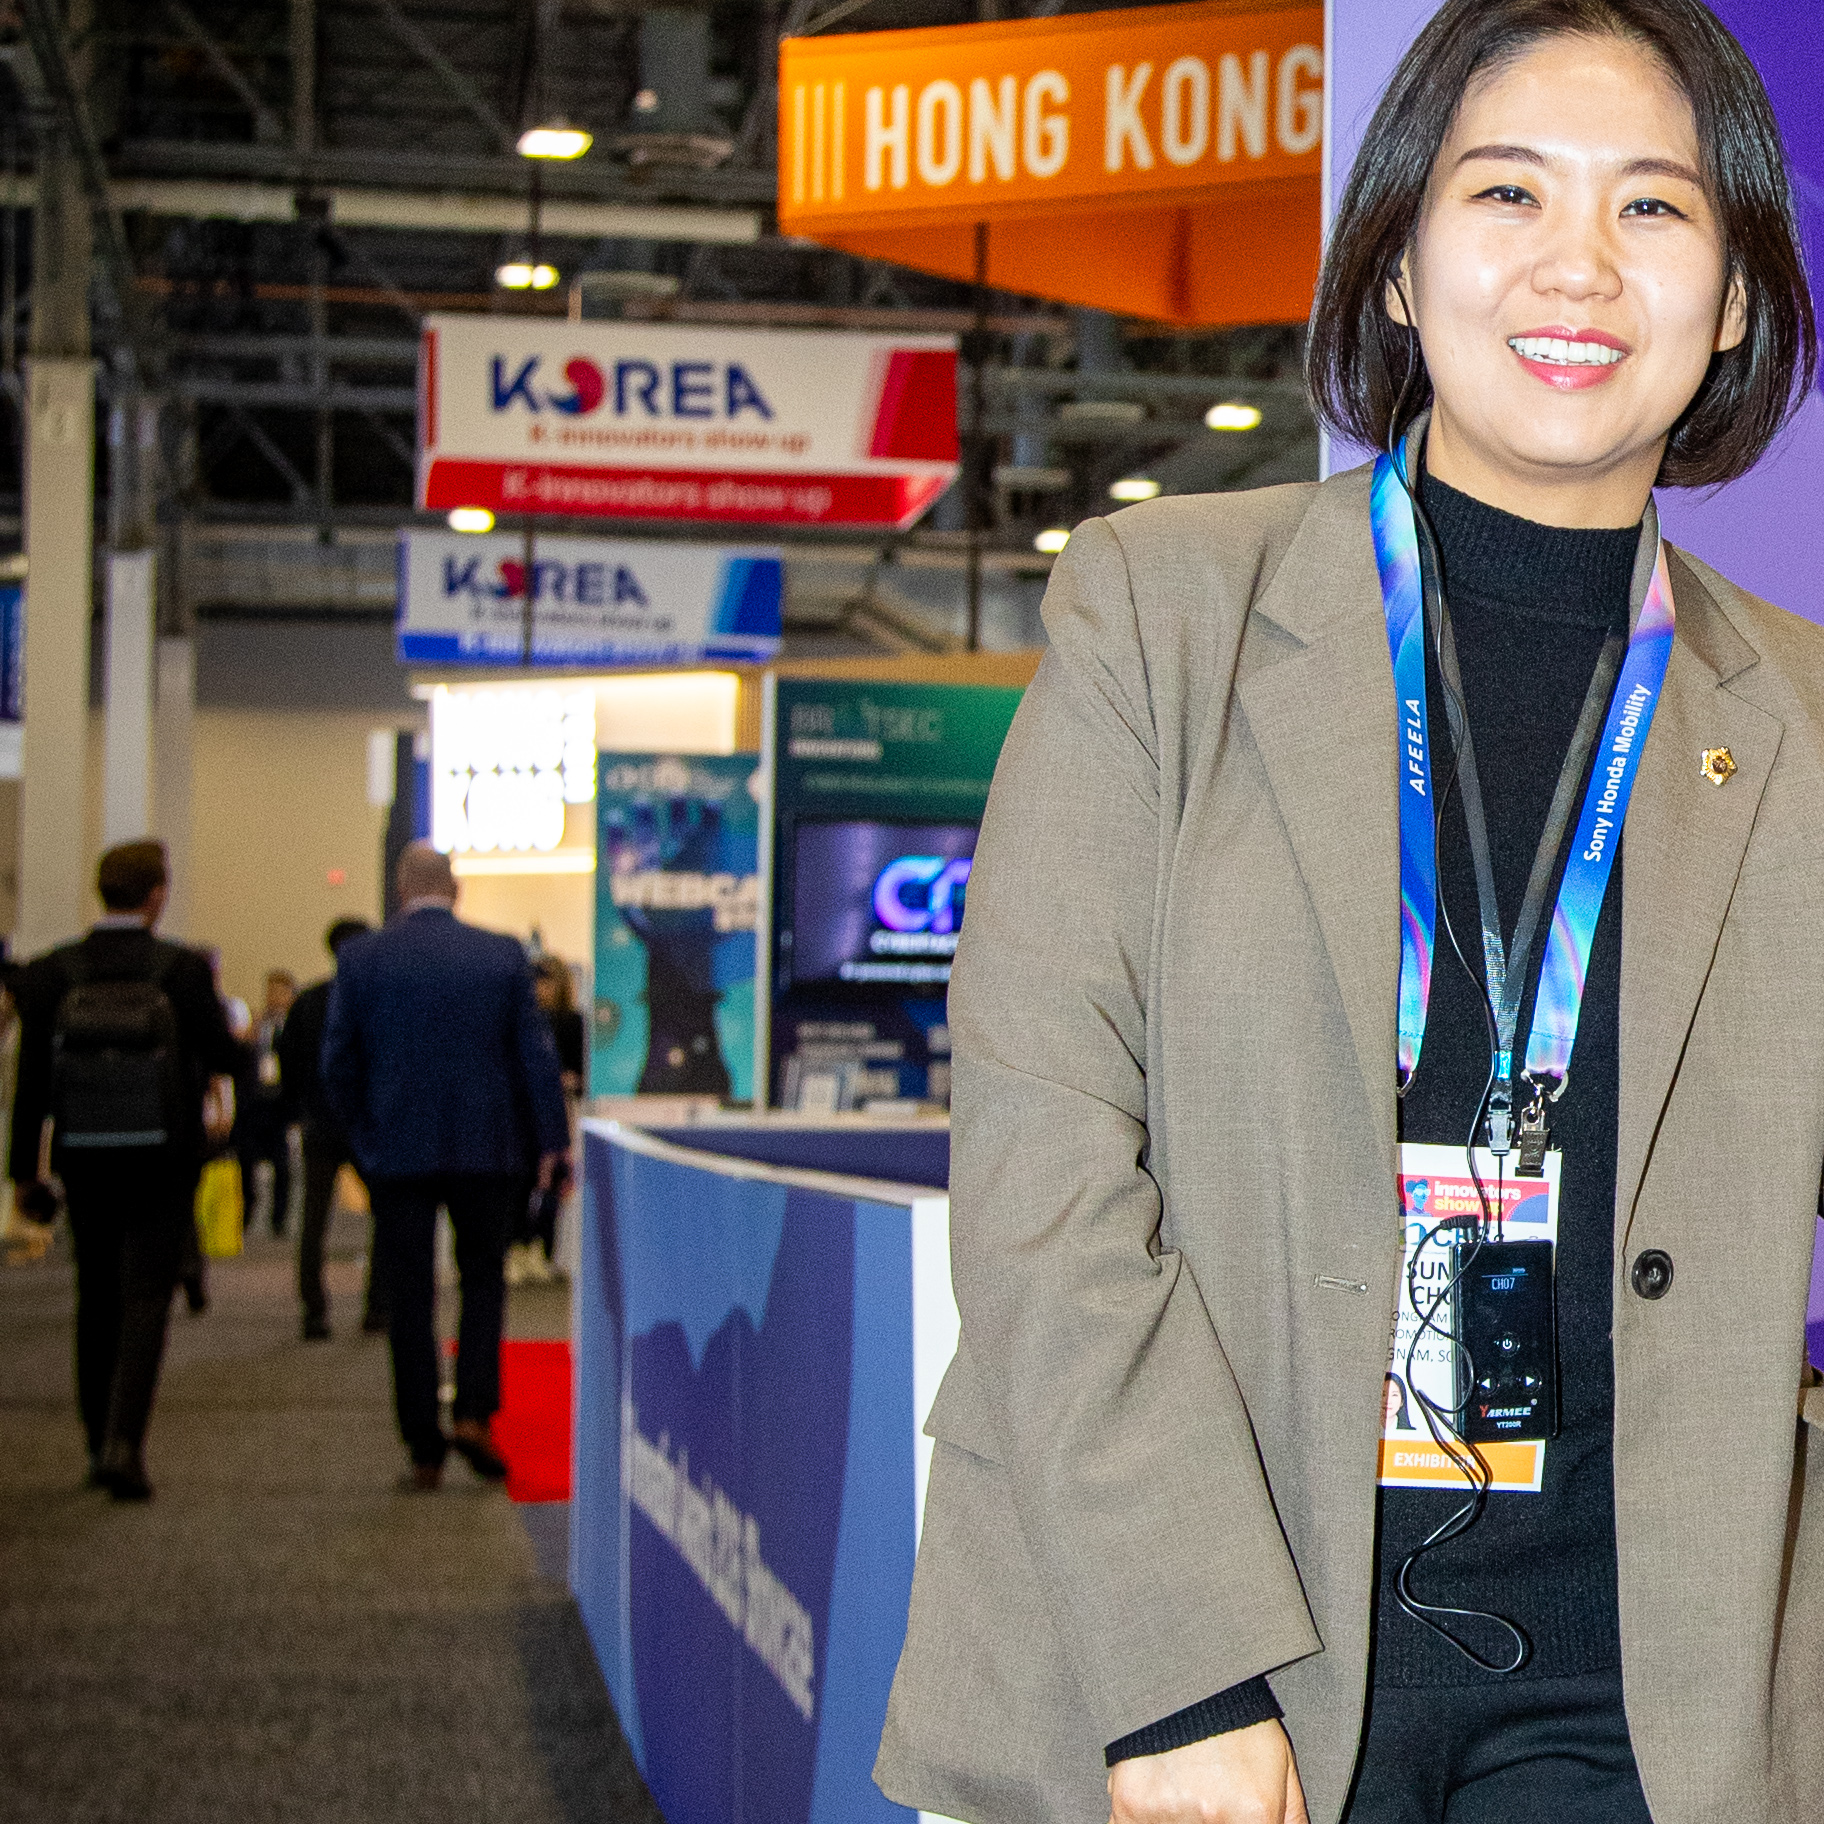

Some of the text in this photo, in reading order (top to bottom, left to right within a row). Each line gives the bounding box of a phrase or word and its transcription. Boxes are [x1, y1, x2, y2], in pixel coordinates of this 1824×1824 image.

[864, 42, 1324, 193] HONG KONG
[487, 352, 776, 421] KOREA
[1405, 699, 1426, 796] AFEELA
[1583, 683, 1652, 863] Sony Honda Mobility
[1434, 1180, 1522, 1200] innovtors
[1434, 1196, 1481, 1212] show
[1491, 1277, 1516, 1291] CH07
[1391, 1310, 1448, 1324] ONGAM
[1479, 1404, 1532, 1418] YARMEE
